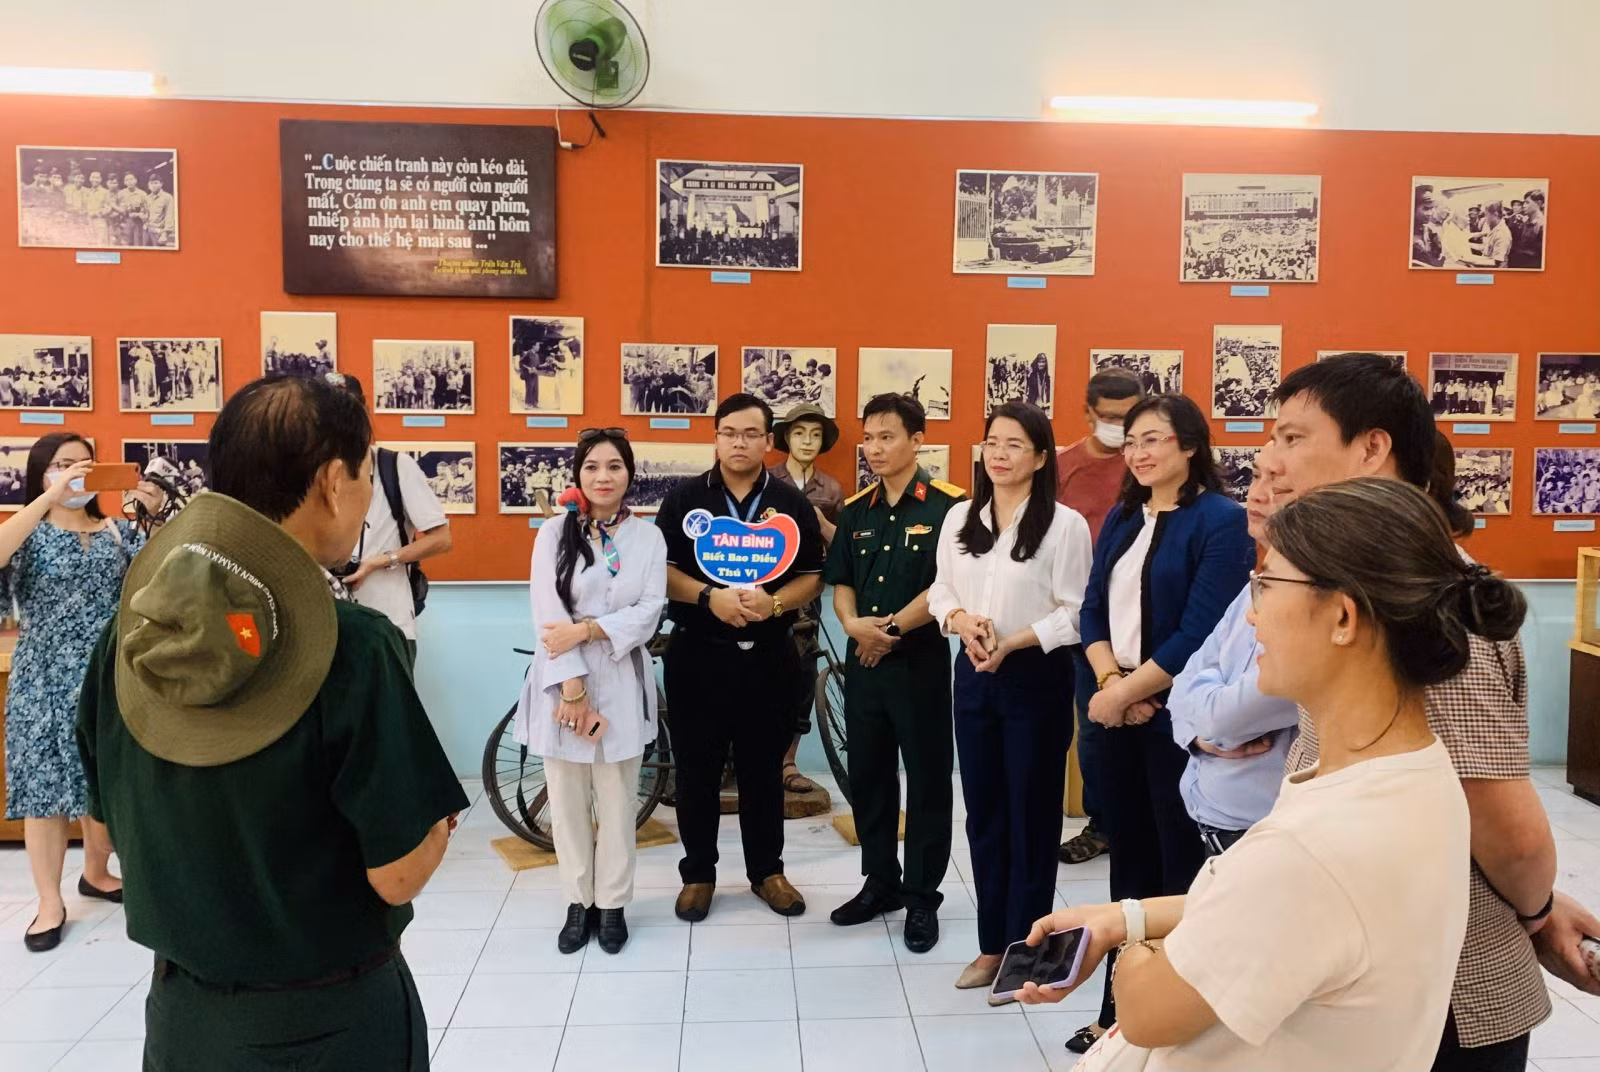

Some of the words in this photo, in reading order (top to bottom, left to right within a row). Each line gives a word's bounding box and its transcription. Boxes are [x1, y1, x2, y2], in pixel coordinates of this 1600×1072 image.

[359, 154, 392, 172] chiến
[395, 157, 429, 173] tranh
[431, 156, 454, 177] này
[456, 157, 478, 174] còn
[480, 158, 504, 175] kéo
[505, 158, 528, 176] dài.
[304, 172, 343, 194] Trong
[345, 174, 383, 195] chúng
[385, 176, 398, 191] ta
[400, 175, 413, 192] sẽ
[416, 175, 431, 192] có
[433, 175, 468, 196] người
[469, 176, 492, 193] còn
[494, 177, 528, 198] người
[307, 190, 340, 209] mất.
[343, 192, 376, 210] Cám
[380, 195, 397, 210] ơn
[400, 194, 427, 211] anh
[430, 199, 452, 211] em
[455, 200, 488, 216] quay
[491, 196, 530, 217] phim,
[308, 209, 350, 232] nhiếp
[352, 210, 380, 228] ảnh
[384, 212, 407, 229] lưu
[410, 213, 429, 233] lại
[432, 213, 465, 230] hình
[468, 213, 496, 231] ảnh
[499, 215, 530, 232] hôm
[309, 234, 336, 250] nay
[338, 230, 364, 247] cho
[367, 228, 393, 247] thế
[396, 231, 414, 251] hệ
[418, 232, 445, 248] mai
[447, 236, 472, 248] sau
[711, 533, 739, 548] TÂN
[741, 533, 775, 549] BÌNH
[702, 551, 725, 562] Biết
[728, 552, 749, 562] Bao
[717, 567, 741, 577] Thú
[744, 568, 758, 580] Vị
